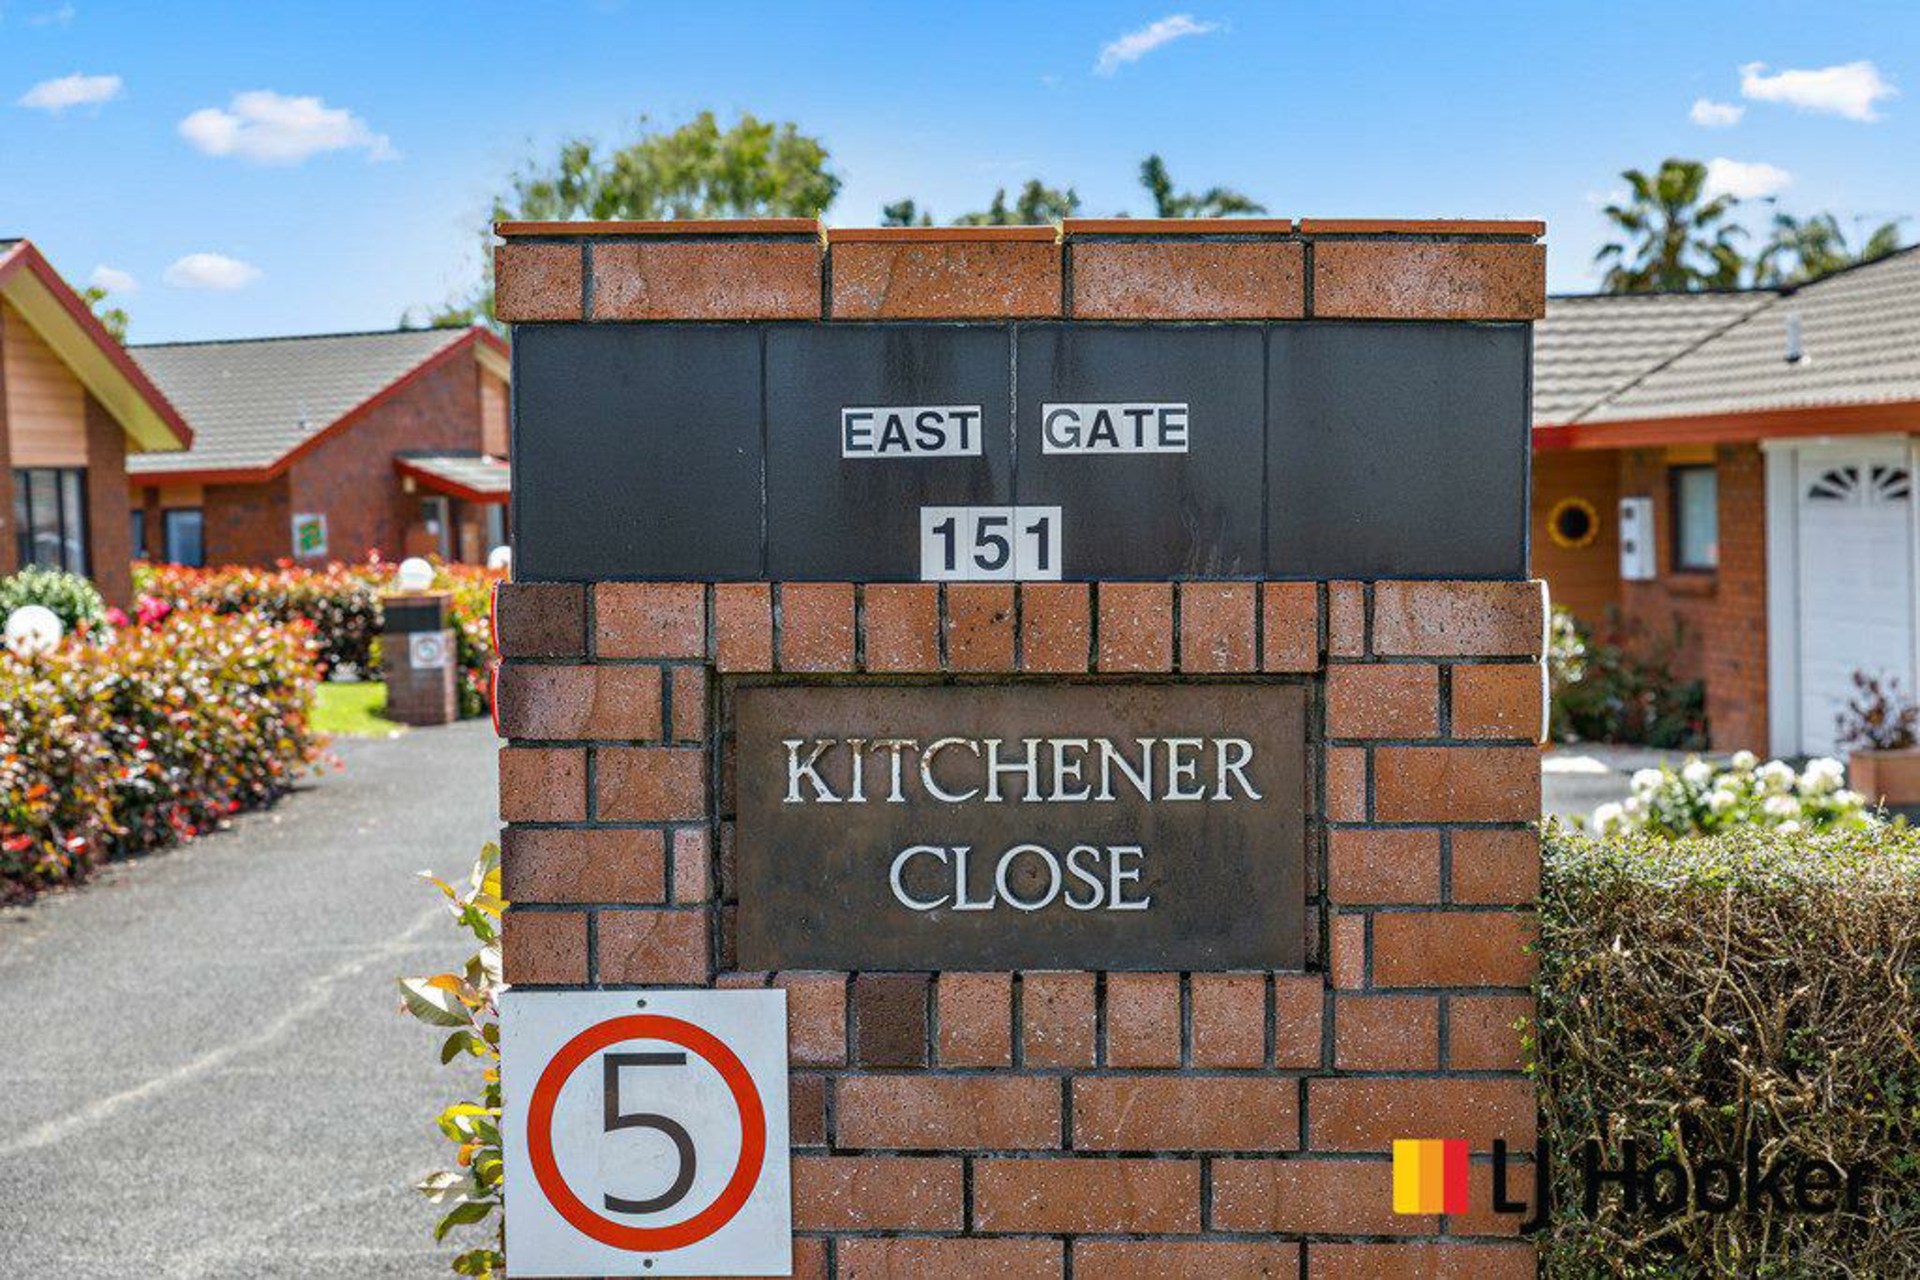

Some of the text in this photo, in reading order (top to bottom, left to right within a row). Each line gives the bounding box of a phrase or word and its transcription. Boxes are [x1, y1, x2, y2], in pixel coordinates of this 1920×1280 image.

[845, 408, 1187, 452] EAST GATE
[932, 516, 1049, 571] 151
[782, 737, 1262, 803] KITCHENER
[889, 844, 1150, 911] CLOSE
[603, 1052, 697, 1215] 5
